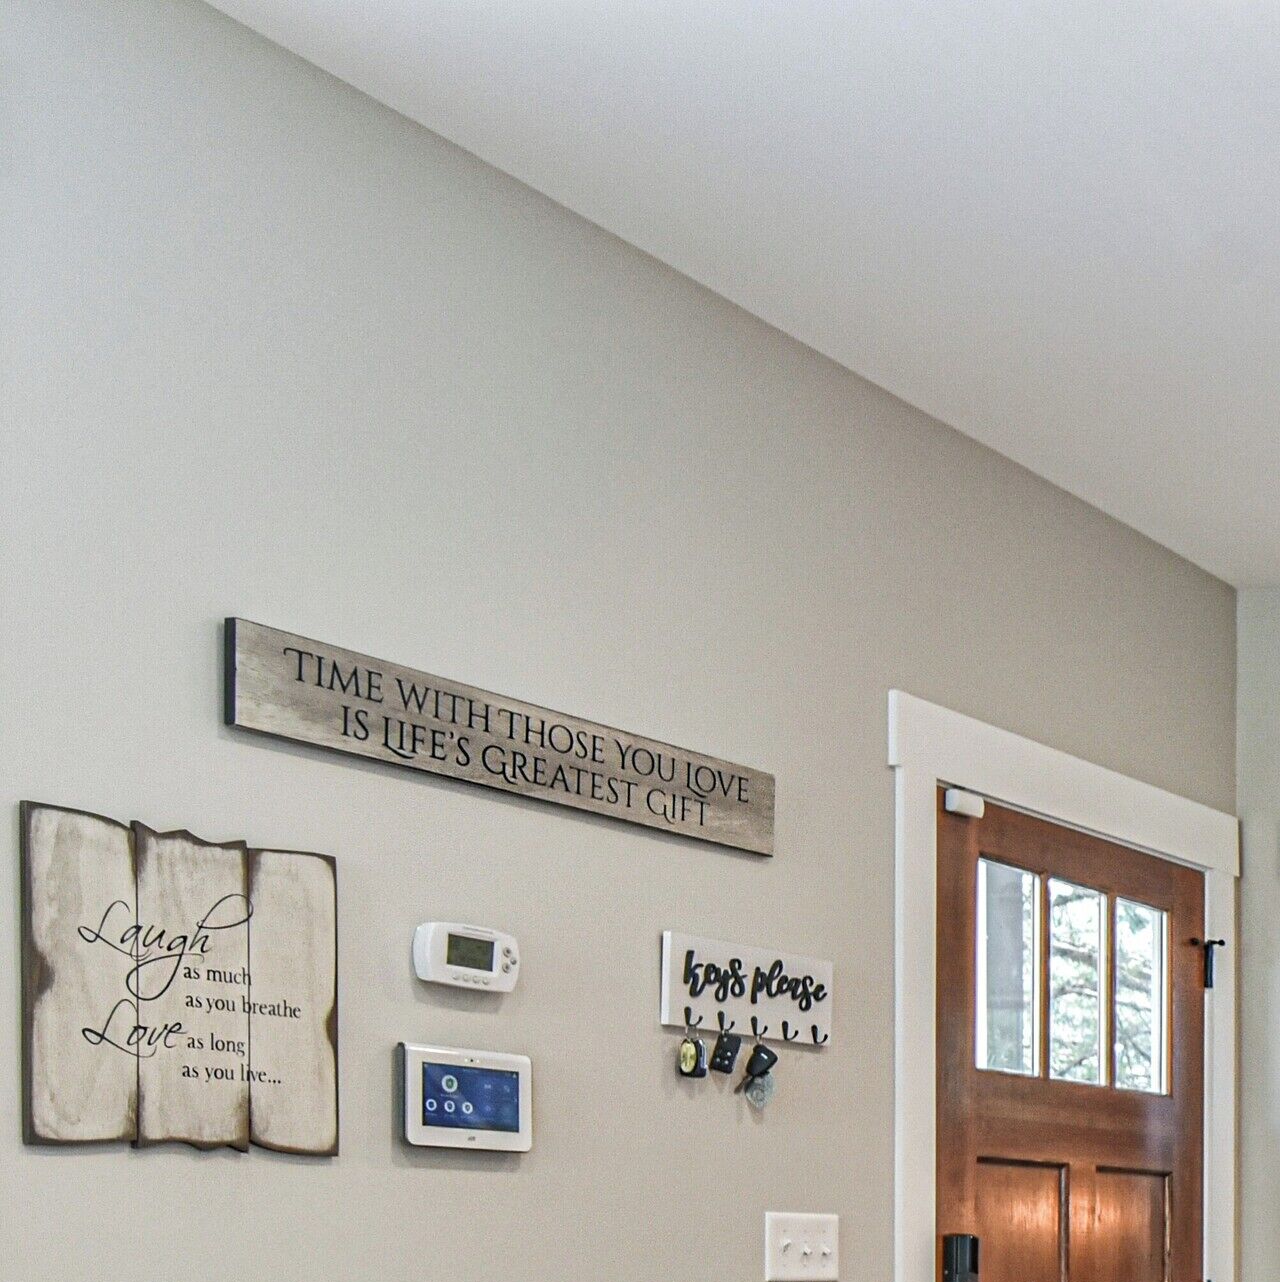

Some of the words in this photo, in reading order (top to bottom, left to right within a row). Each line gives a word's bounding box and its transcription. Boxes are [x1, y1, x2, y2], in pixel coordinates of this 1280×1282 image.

[283, 647, 384, 704] TIME
[395, 677, 493, 733] WITH
[498, 708, 605, 764] THOSE
[614, 738, 676, 783] YOU
[686, 762, 750, 804] LOVE
[341, 705, 370, 742] IS
[382, 716, 471, 767] LIFE'S
[481, 744, 638, 808] GREATEST
[646, 788, 711, 827] GIFT
[78, 893, 254, 1001] Laugh
[183, 965, 201, 980] as
[206, 966, 252, 986] much
[185, 994, 203, 1009] as
[206, 996, 236, 1014] you
[242, 995, 301, 1019] breathe
[683, 949, 748, 1003] keys
[750, 959, 828, 1012] please
[82, 998, 188, 1058] Love
[187, 1036, 204, 1050] as
[210, 1032, 246, 1057] long
[182, 1064, 199, 1079] as
[205, 1066, 235, 1083] you
